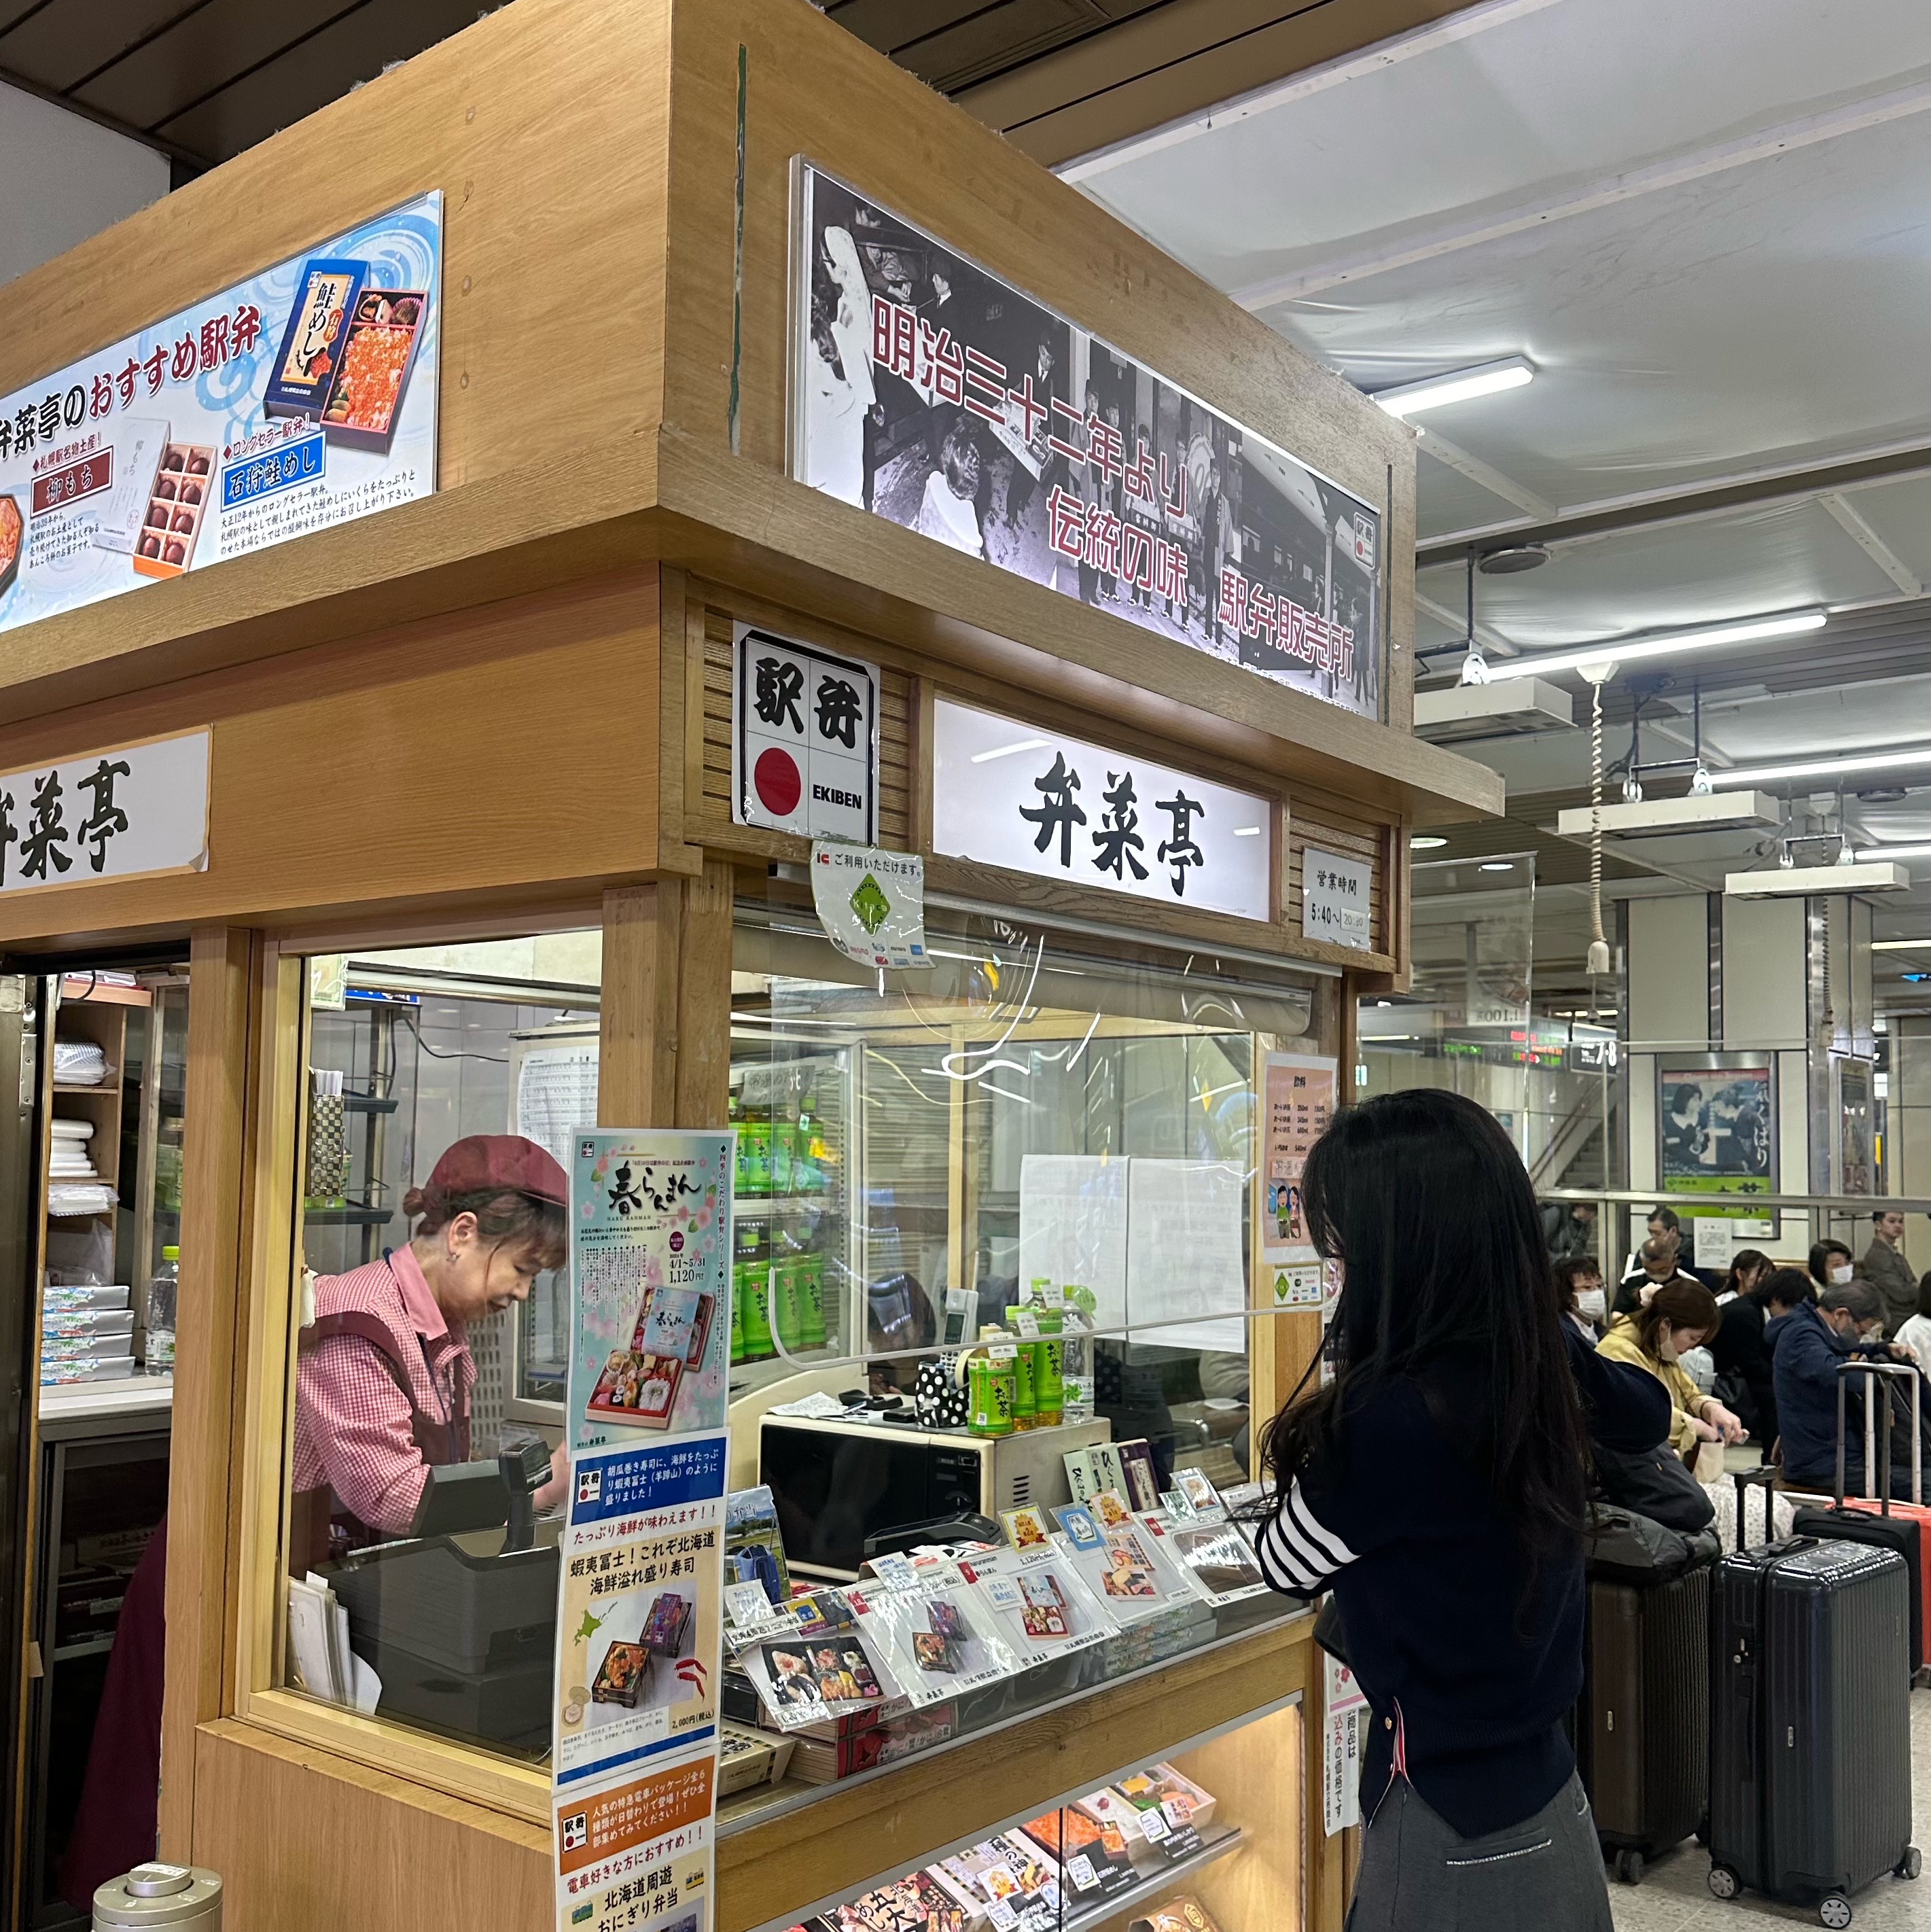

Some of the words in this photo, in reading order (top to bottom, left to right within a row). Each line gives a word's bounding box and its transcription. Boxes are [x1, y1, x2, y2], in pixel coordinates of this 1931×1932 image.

[303, 283, 337, 356] 鮭めし
[325, 311, 342, 339] 石狩
[872, 294, 1189, 519] 明治三十二年より
[46, 465, 94, 504] 柳もち
[229, 447, 316, 498] 石狩鮭めし
[1046, 486, 1189, 607] 伝統の味
[1217, 567, 1355, 682] 駅弁販売所
[754, 657, 862, 749] 駅弁
[813, 784, 862, 809] EKIBEN
[1019, 750, 1205, 897] 弁菜亭
[834, 853, 921, 877] ご利用いただけます。
[1317, 870, 1358, 896] 営業時間
[853, 898, 888, 912] Kitaca
[607, 1159, 702, 1215] 春らんまん
[718, 1155, 726, 1269] 四季のこだわり駅弁シリーズ
[1046, 1342, 1061, 1377] お茶
[993, 1386, 1010, 1418] お茶
[607, 1449, 720, 1477] 胡瓜巻き寿司に、海鮮をたっぷ
[605, 1486, 652, 1507] 盛りました！
[573, 1505, 715, 1545] たっぷり海鮮が味わえます！！
[590, 1556, 696, 1596] 海鮮溢れ盛り寿司
[592, 1784, 706, 1833] 種類が日替わりで登場！ぜひ全
[592, 1802, 688, 1848] 部集めてみてください！！
[567, 1826, 703, 1895] 電車好きな方におすすめ！！
[598, 1887, 678, 1932] おにぎり弁当
[604, 1864, 673, 1912] 北海道周遊
